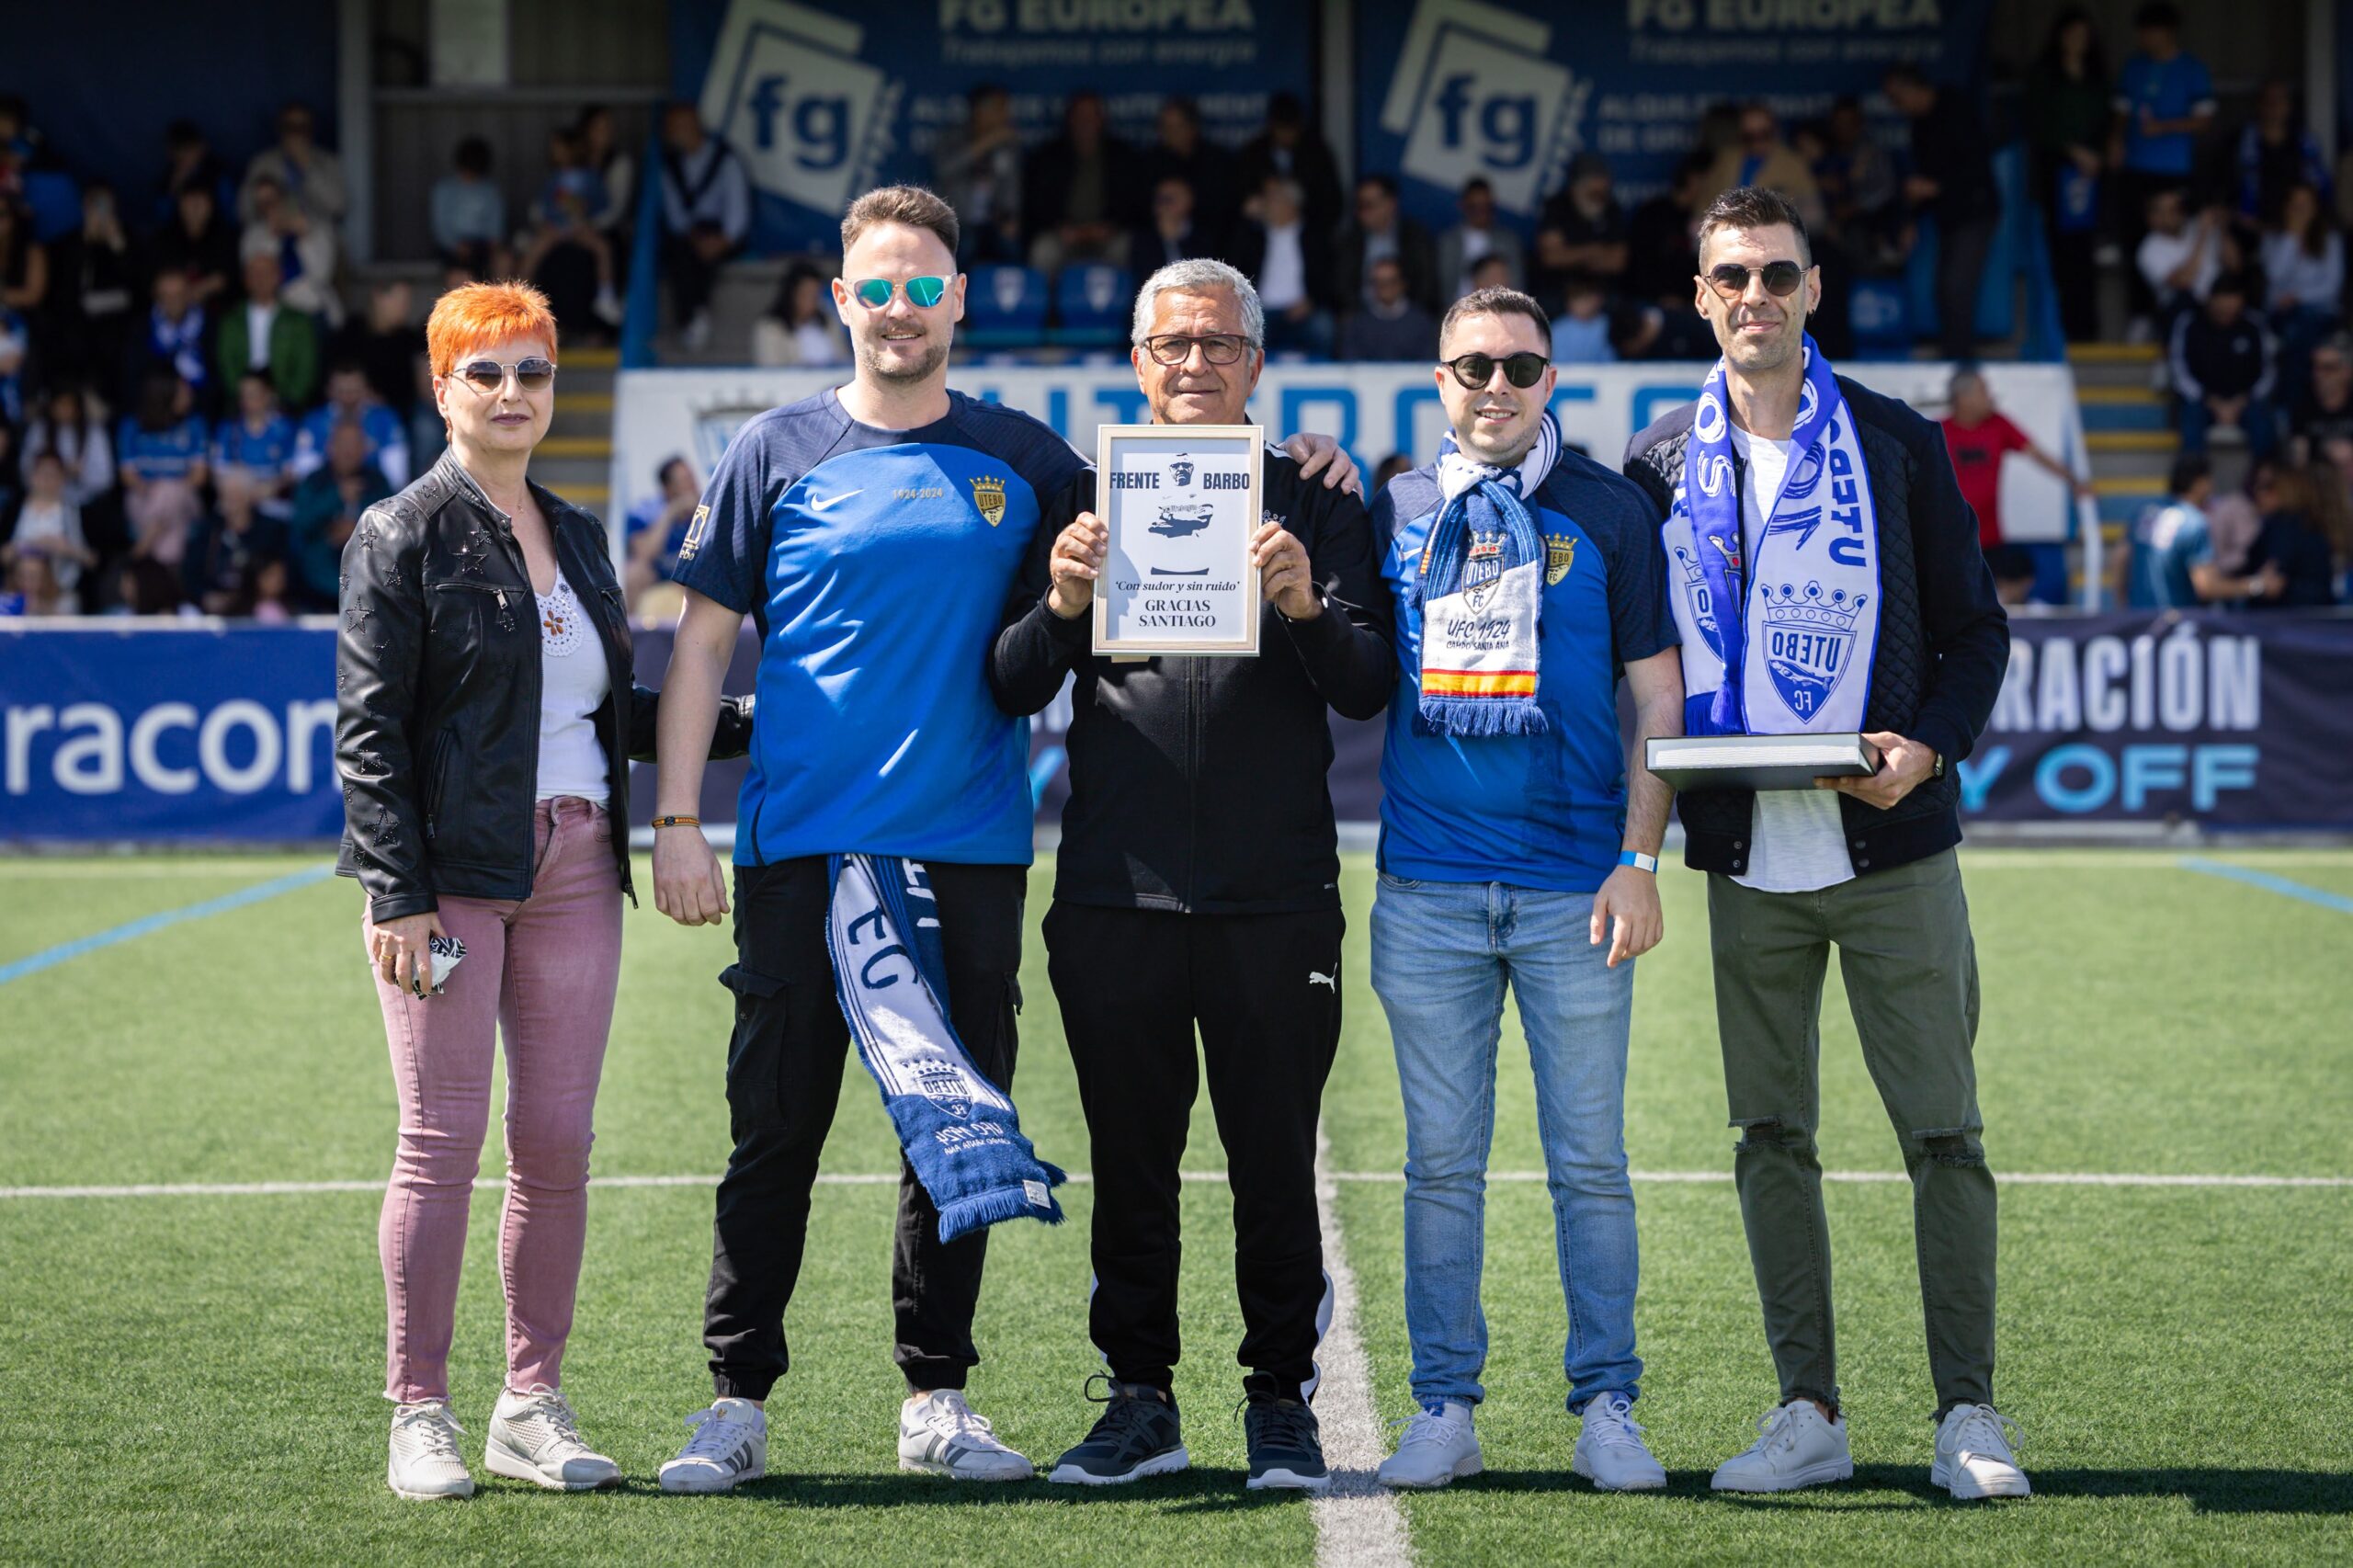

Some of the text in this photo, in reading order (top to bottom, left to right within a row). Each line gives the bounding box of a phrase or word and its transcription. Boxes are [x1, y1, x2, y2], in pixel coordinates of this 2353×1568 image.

[1015, 0, 1255, 31] EUROPEA
[747, 74, 848, 172] fg
[1433, 74, 1538, 172] fg
[1109, 472, 1250, 490] FRENTE BARBO
[892, 487, 943, 500] 1924-2024
[978, 494, 1003, 507] UTEBO
[989, 514, 998, 523] FC
[1466, 560, 1499, 585] UTEBO
[1549, 574, 1558, 582] FC
[1142, 581, 1176, 592] sudor
[1176, 584, 1185, 594] y
[1187, 581, 1203, 592] sin
[1144, 599, 1211, 612] GRACIAS
[1472, 595, 1484, 608] FC
[1138, 614, 1217, 628] SANTIAGO
[1448, 619, 1511, 641] UFC 1924
[2034, 743, 2261, 813] OFF
